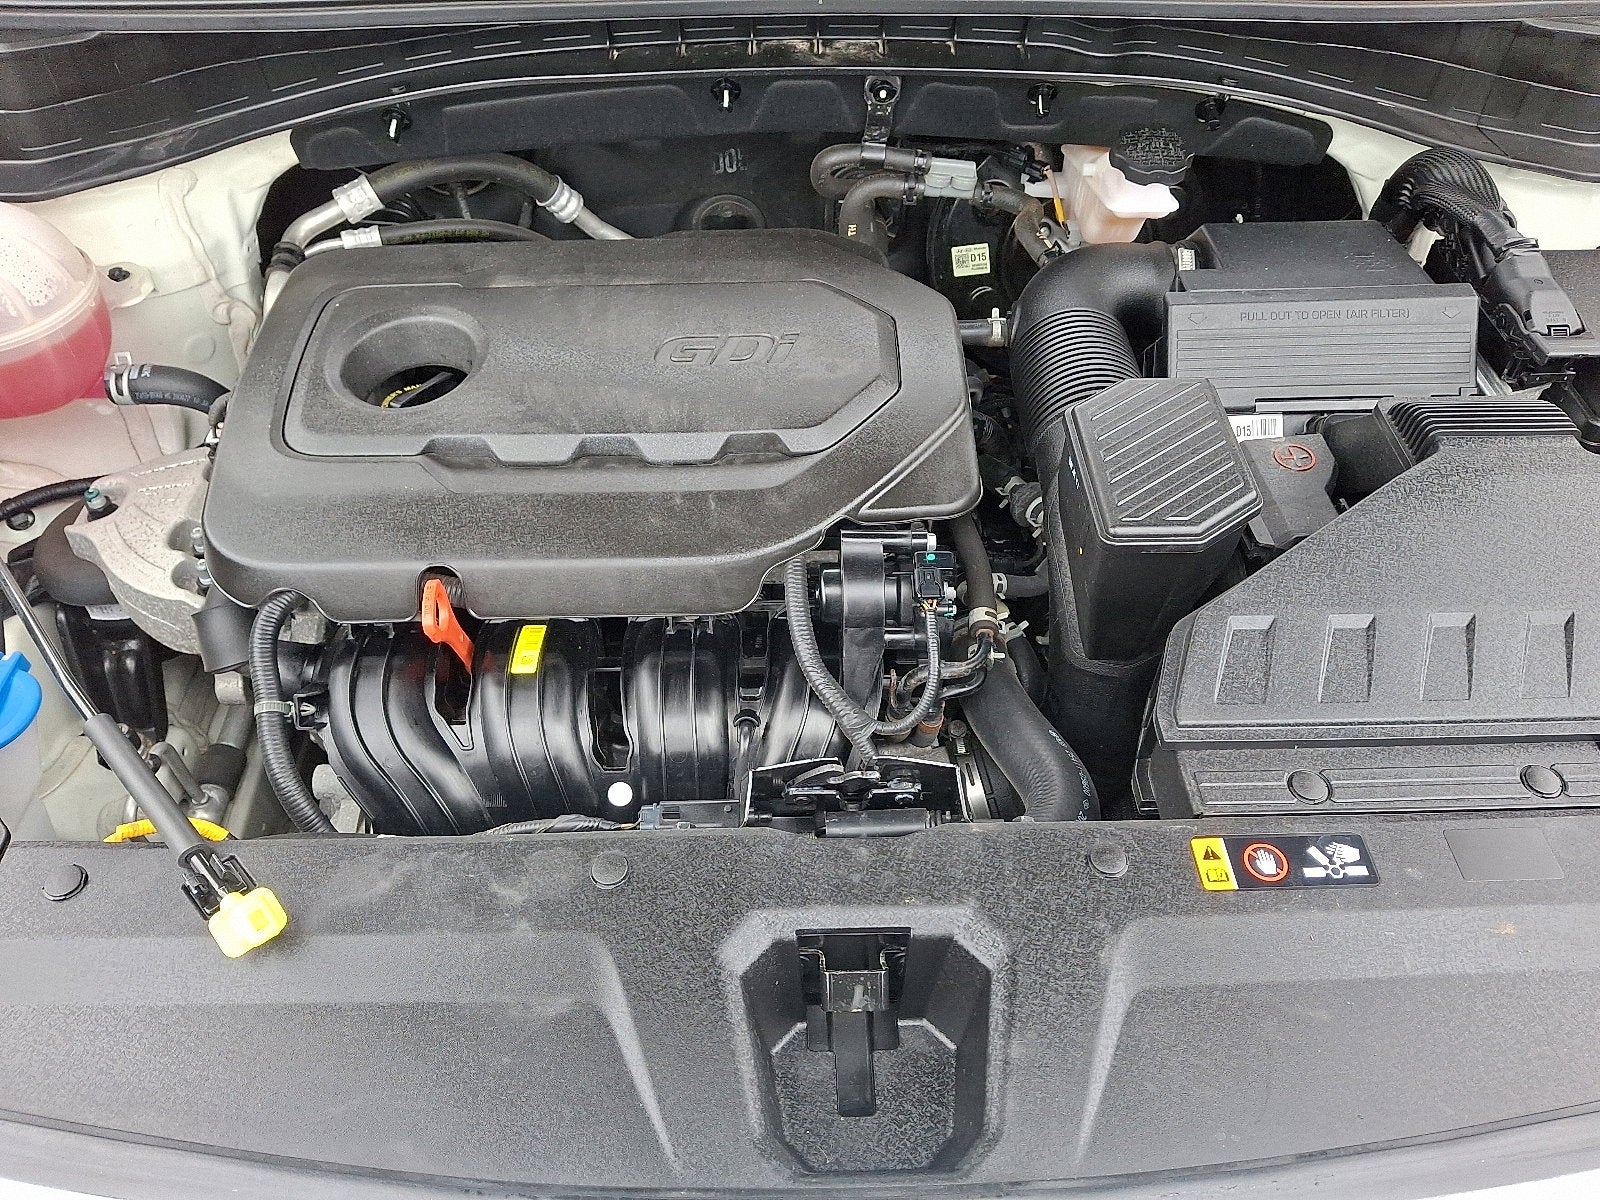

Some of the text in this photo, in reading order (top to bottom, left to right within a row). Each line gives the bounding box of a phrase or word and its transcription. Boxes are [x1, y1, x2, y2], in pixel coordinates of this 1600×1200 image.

[970, 252, 987, 263] D15
[1240, 311, 1268, 322] PULL
[1270, 311, 1292, 321] OUT
[1294, 310, 1309, 320] TO
[1311, 309, 1341, 320] OPEN
[1371, 308, 1410, 319] FILTER)
[1236, 425, 1252, 437] D15
